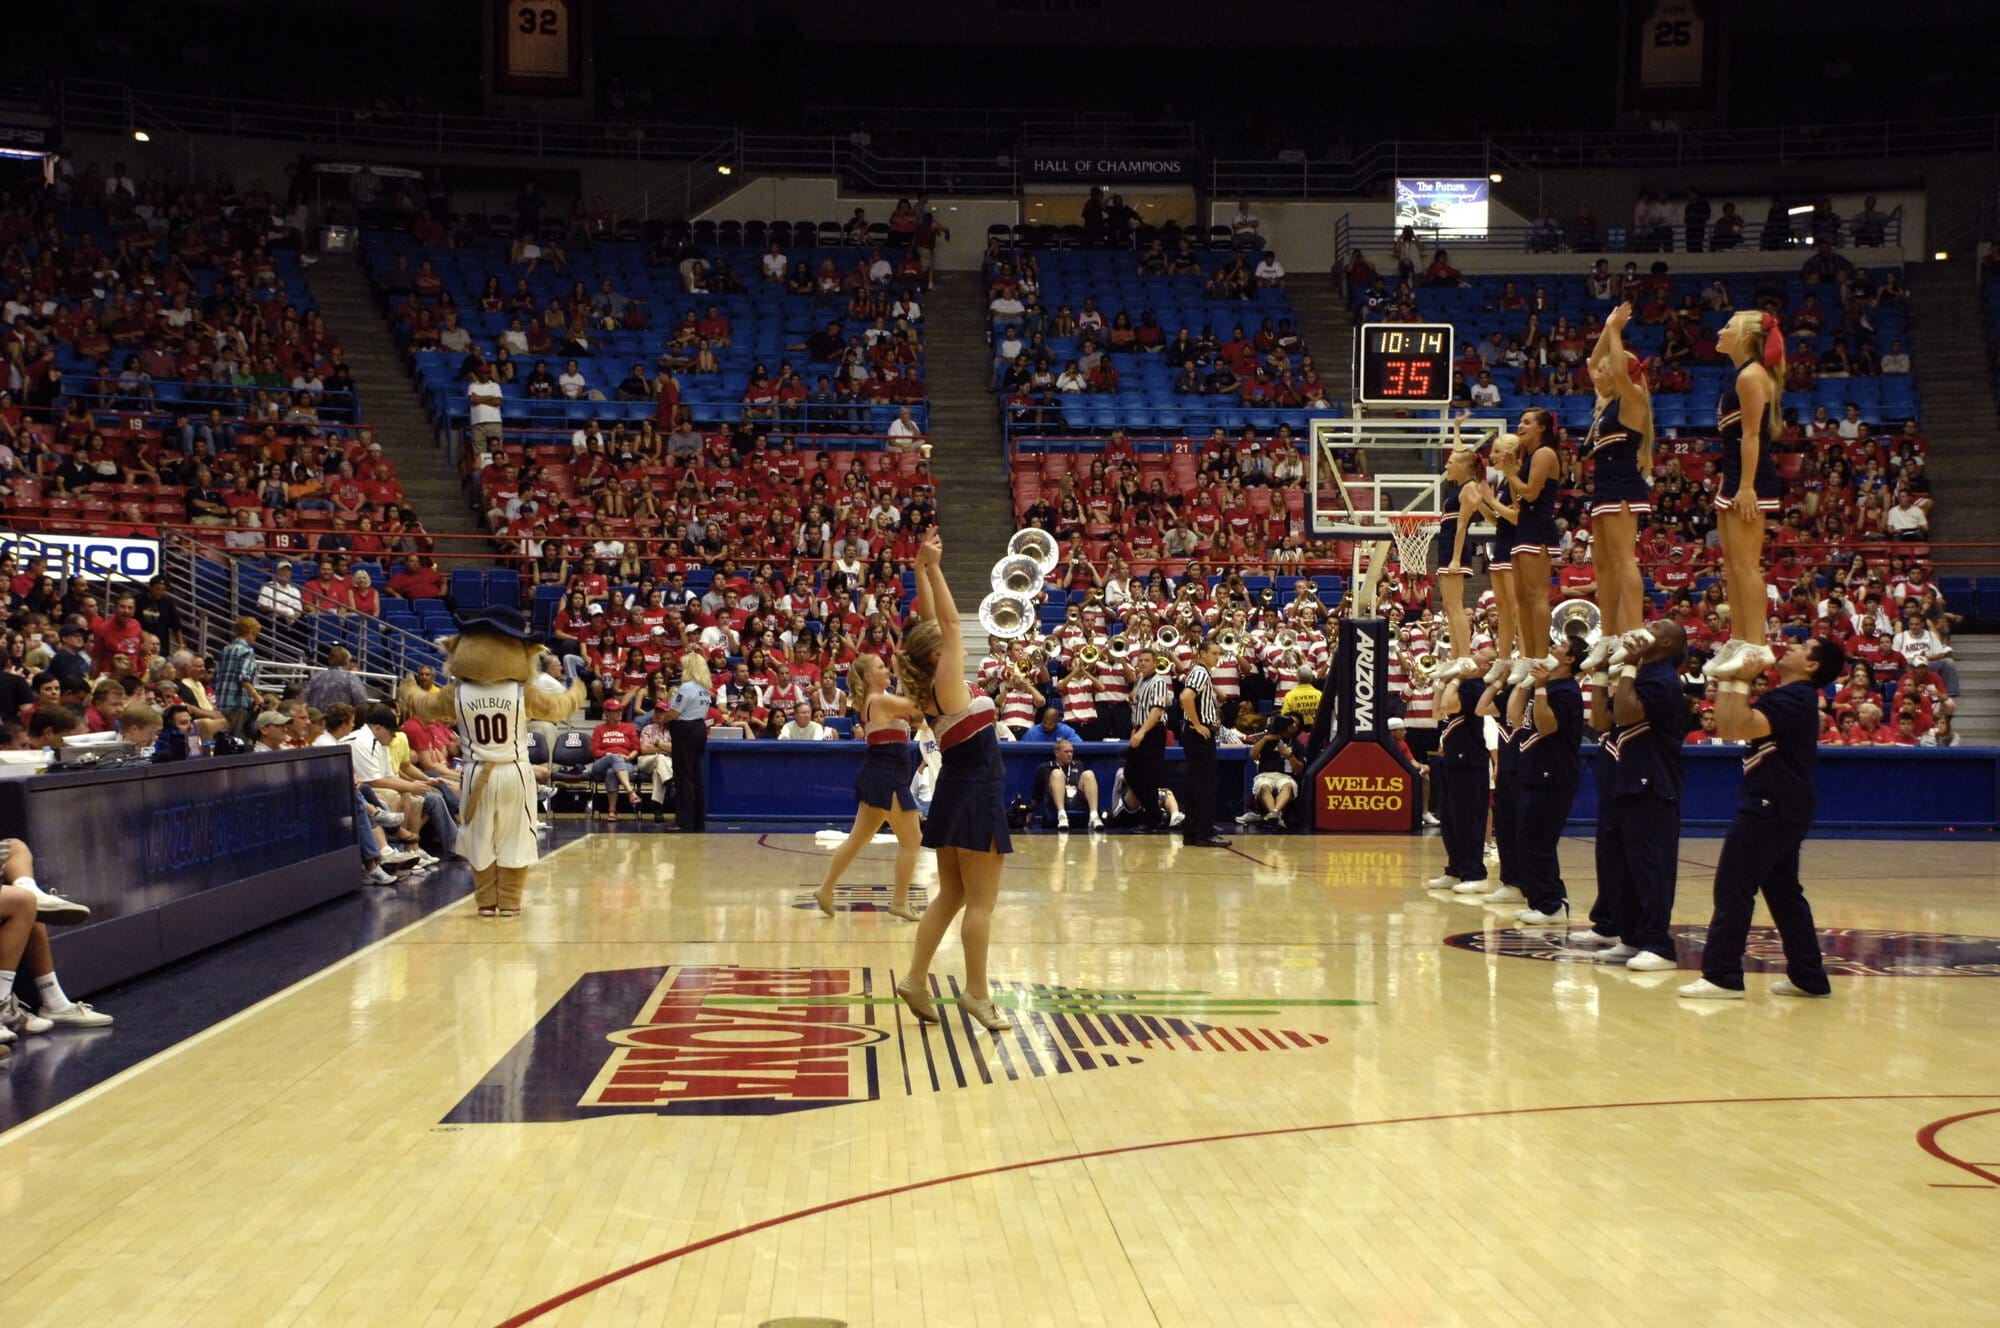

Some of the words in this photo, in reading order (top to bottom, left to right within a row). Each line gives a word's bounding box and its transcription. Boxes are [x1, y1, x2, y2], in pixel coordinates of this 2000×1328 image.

[519, 8, 557, 34] 32
[1655, 21, 1690, 46] 25
[1034, 159, 1069, 172] HALL
[1075, 159, 1092, 172] OF
[1097, 159, 1181, 173] CHAMPIONS
[1416, 181, 1433, 191] The
[1380, 332, 1442, 353] 10:14
[1383, 361, 1431, 395] 35
[129, 418, 143, 430] 19
[1175, 443, 1188, 453] 21
[1674, 443, 1689, 454] 22
[276, 534, 289, 548] 19
[1, 541, 156, 576] GEICO
[1355, 627, 1375, 734] ARIZONA
[467, 697, 512, 711] WILBUR
[474, 712, 508, 746] 00
[1324, 776, 1404, 792] WELLS
[1327, 794, 1402, 811] FARGO
